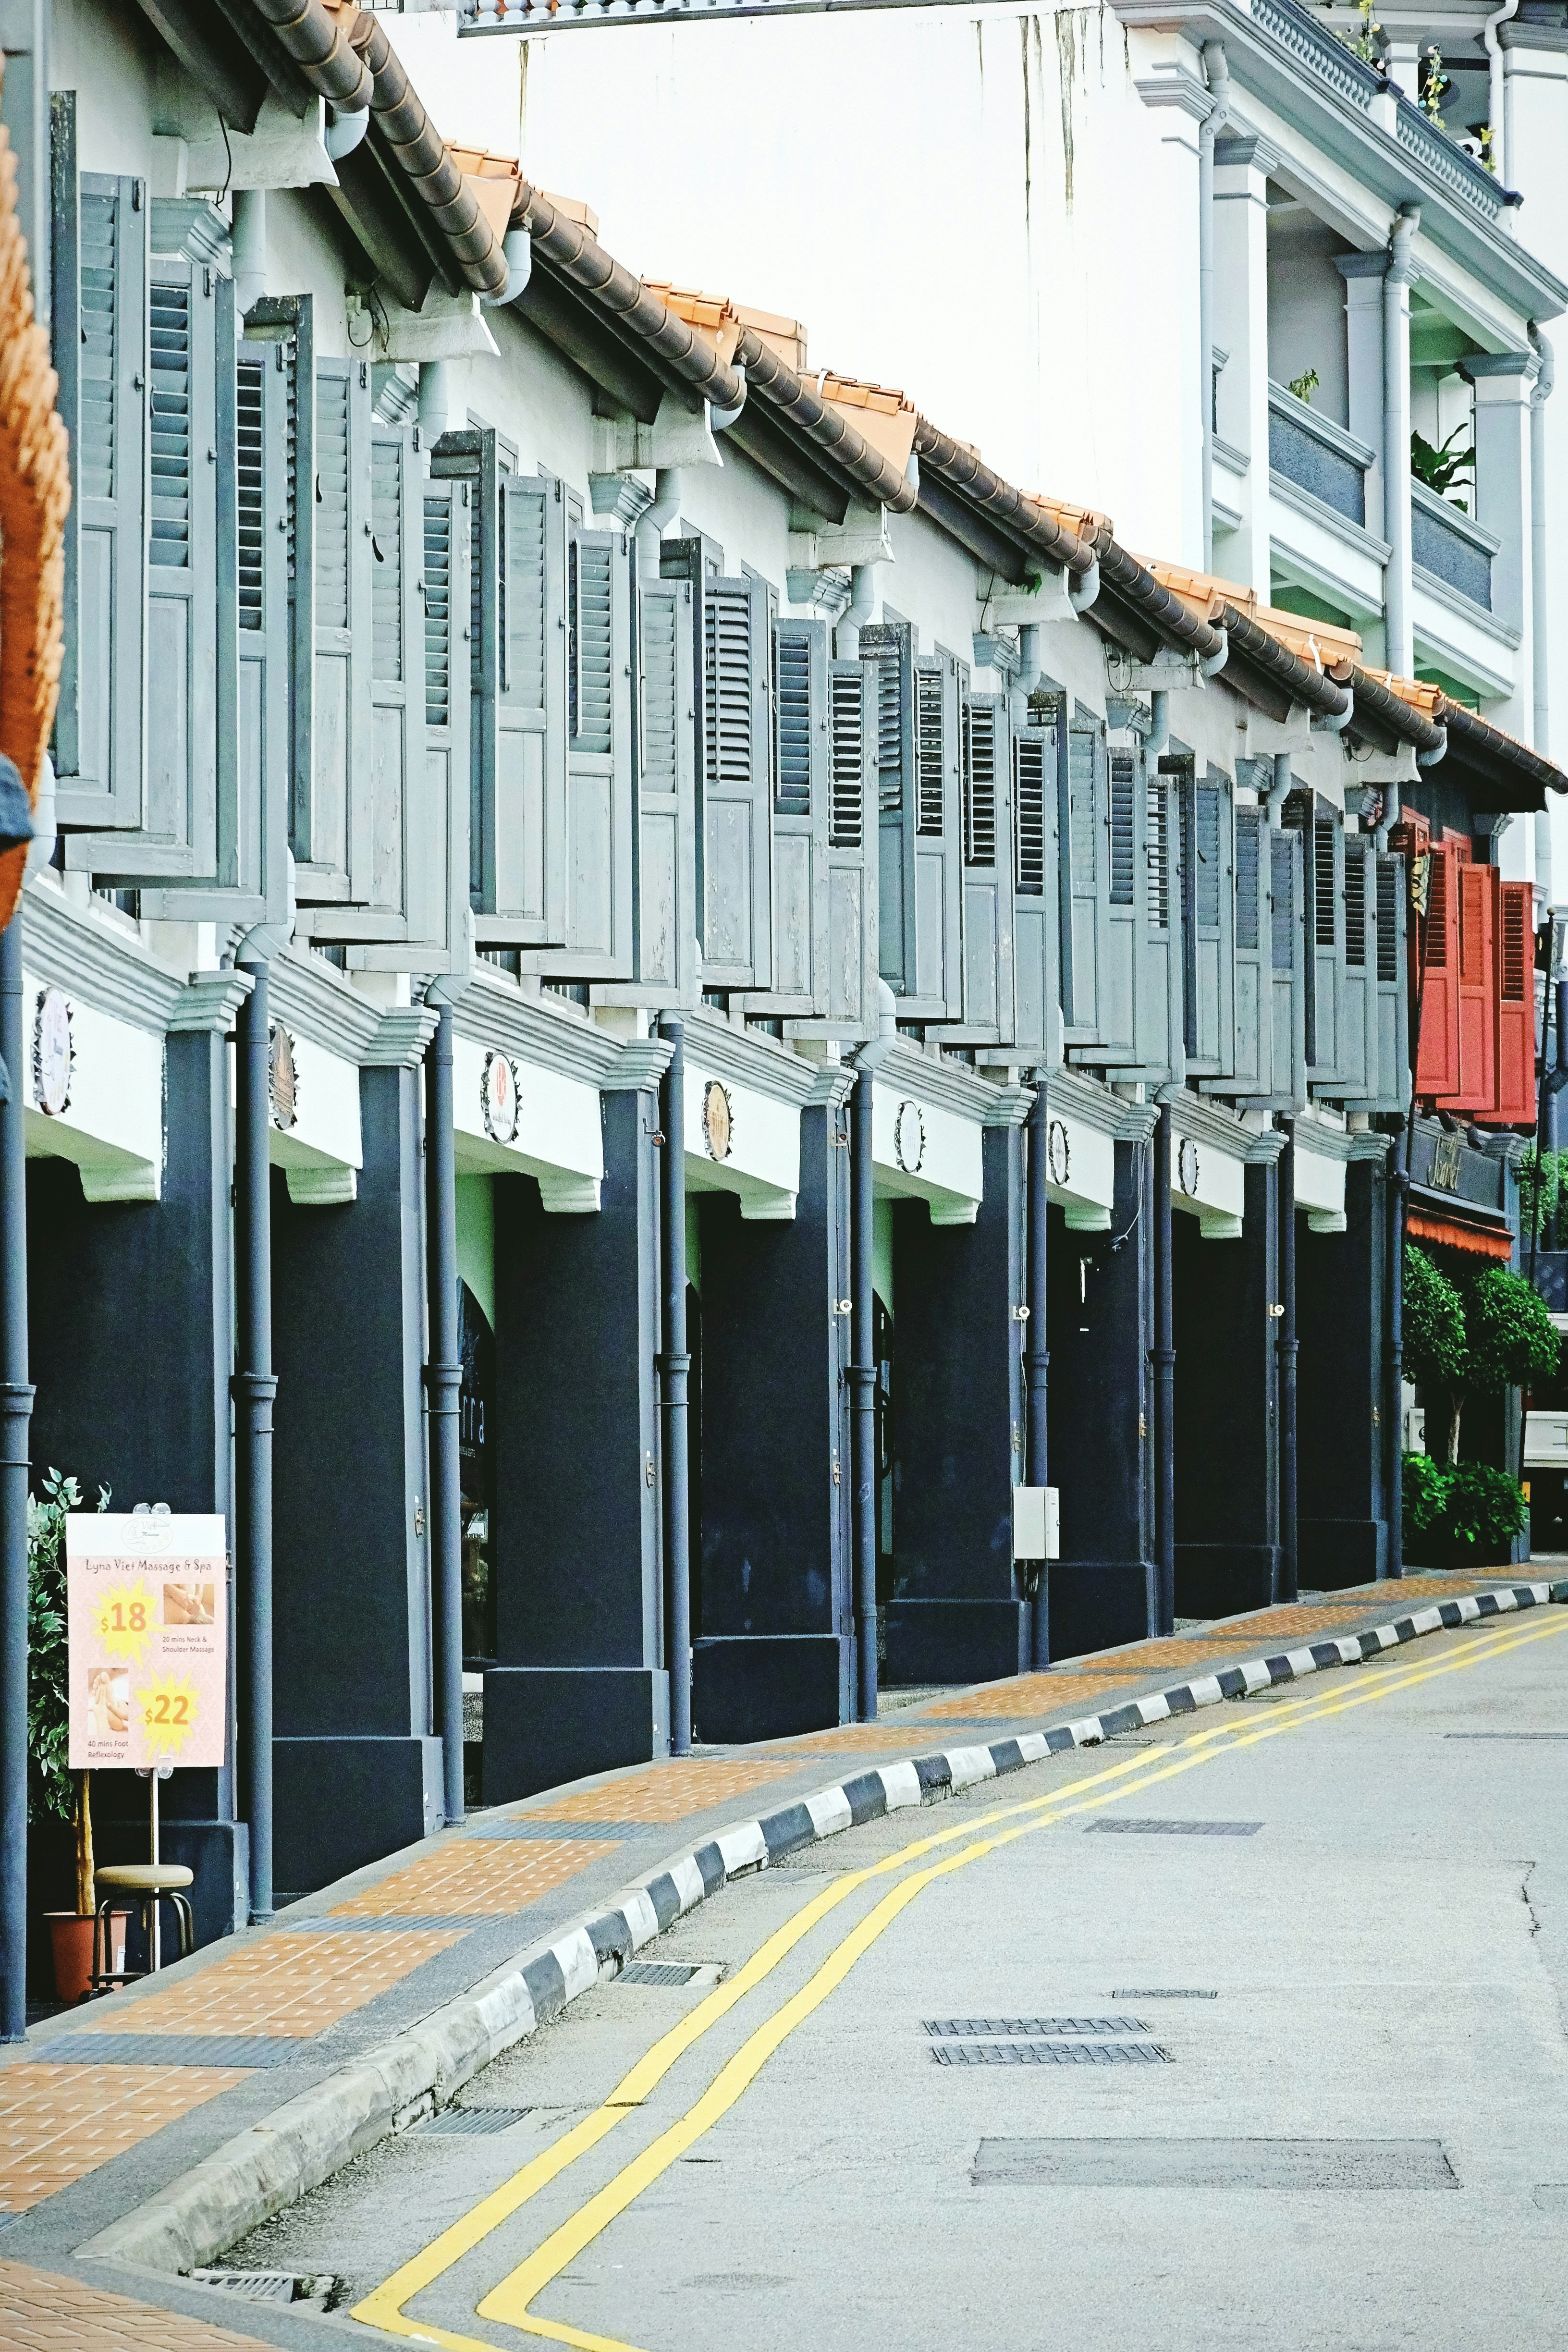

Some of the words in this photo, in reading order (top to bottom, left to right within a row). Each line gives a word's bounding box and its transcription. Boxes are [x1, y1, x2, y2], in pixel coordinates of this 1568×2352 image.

[86, 1559, 111, 1574] Lyna
[114, 1559, 134, 1571] Viet
[137, 1559, 181, 1573] Massage
[184, 1559, 191, 1570] &
[194, 1559, 211, 1573] Spa
[101, 1602, 146, 1634] $18
[145, 1694, 188, 1726] $22
[88, 1751, 124, 1759] Reflexology
